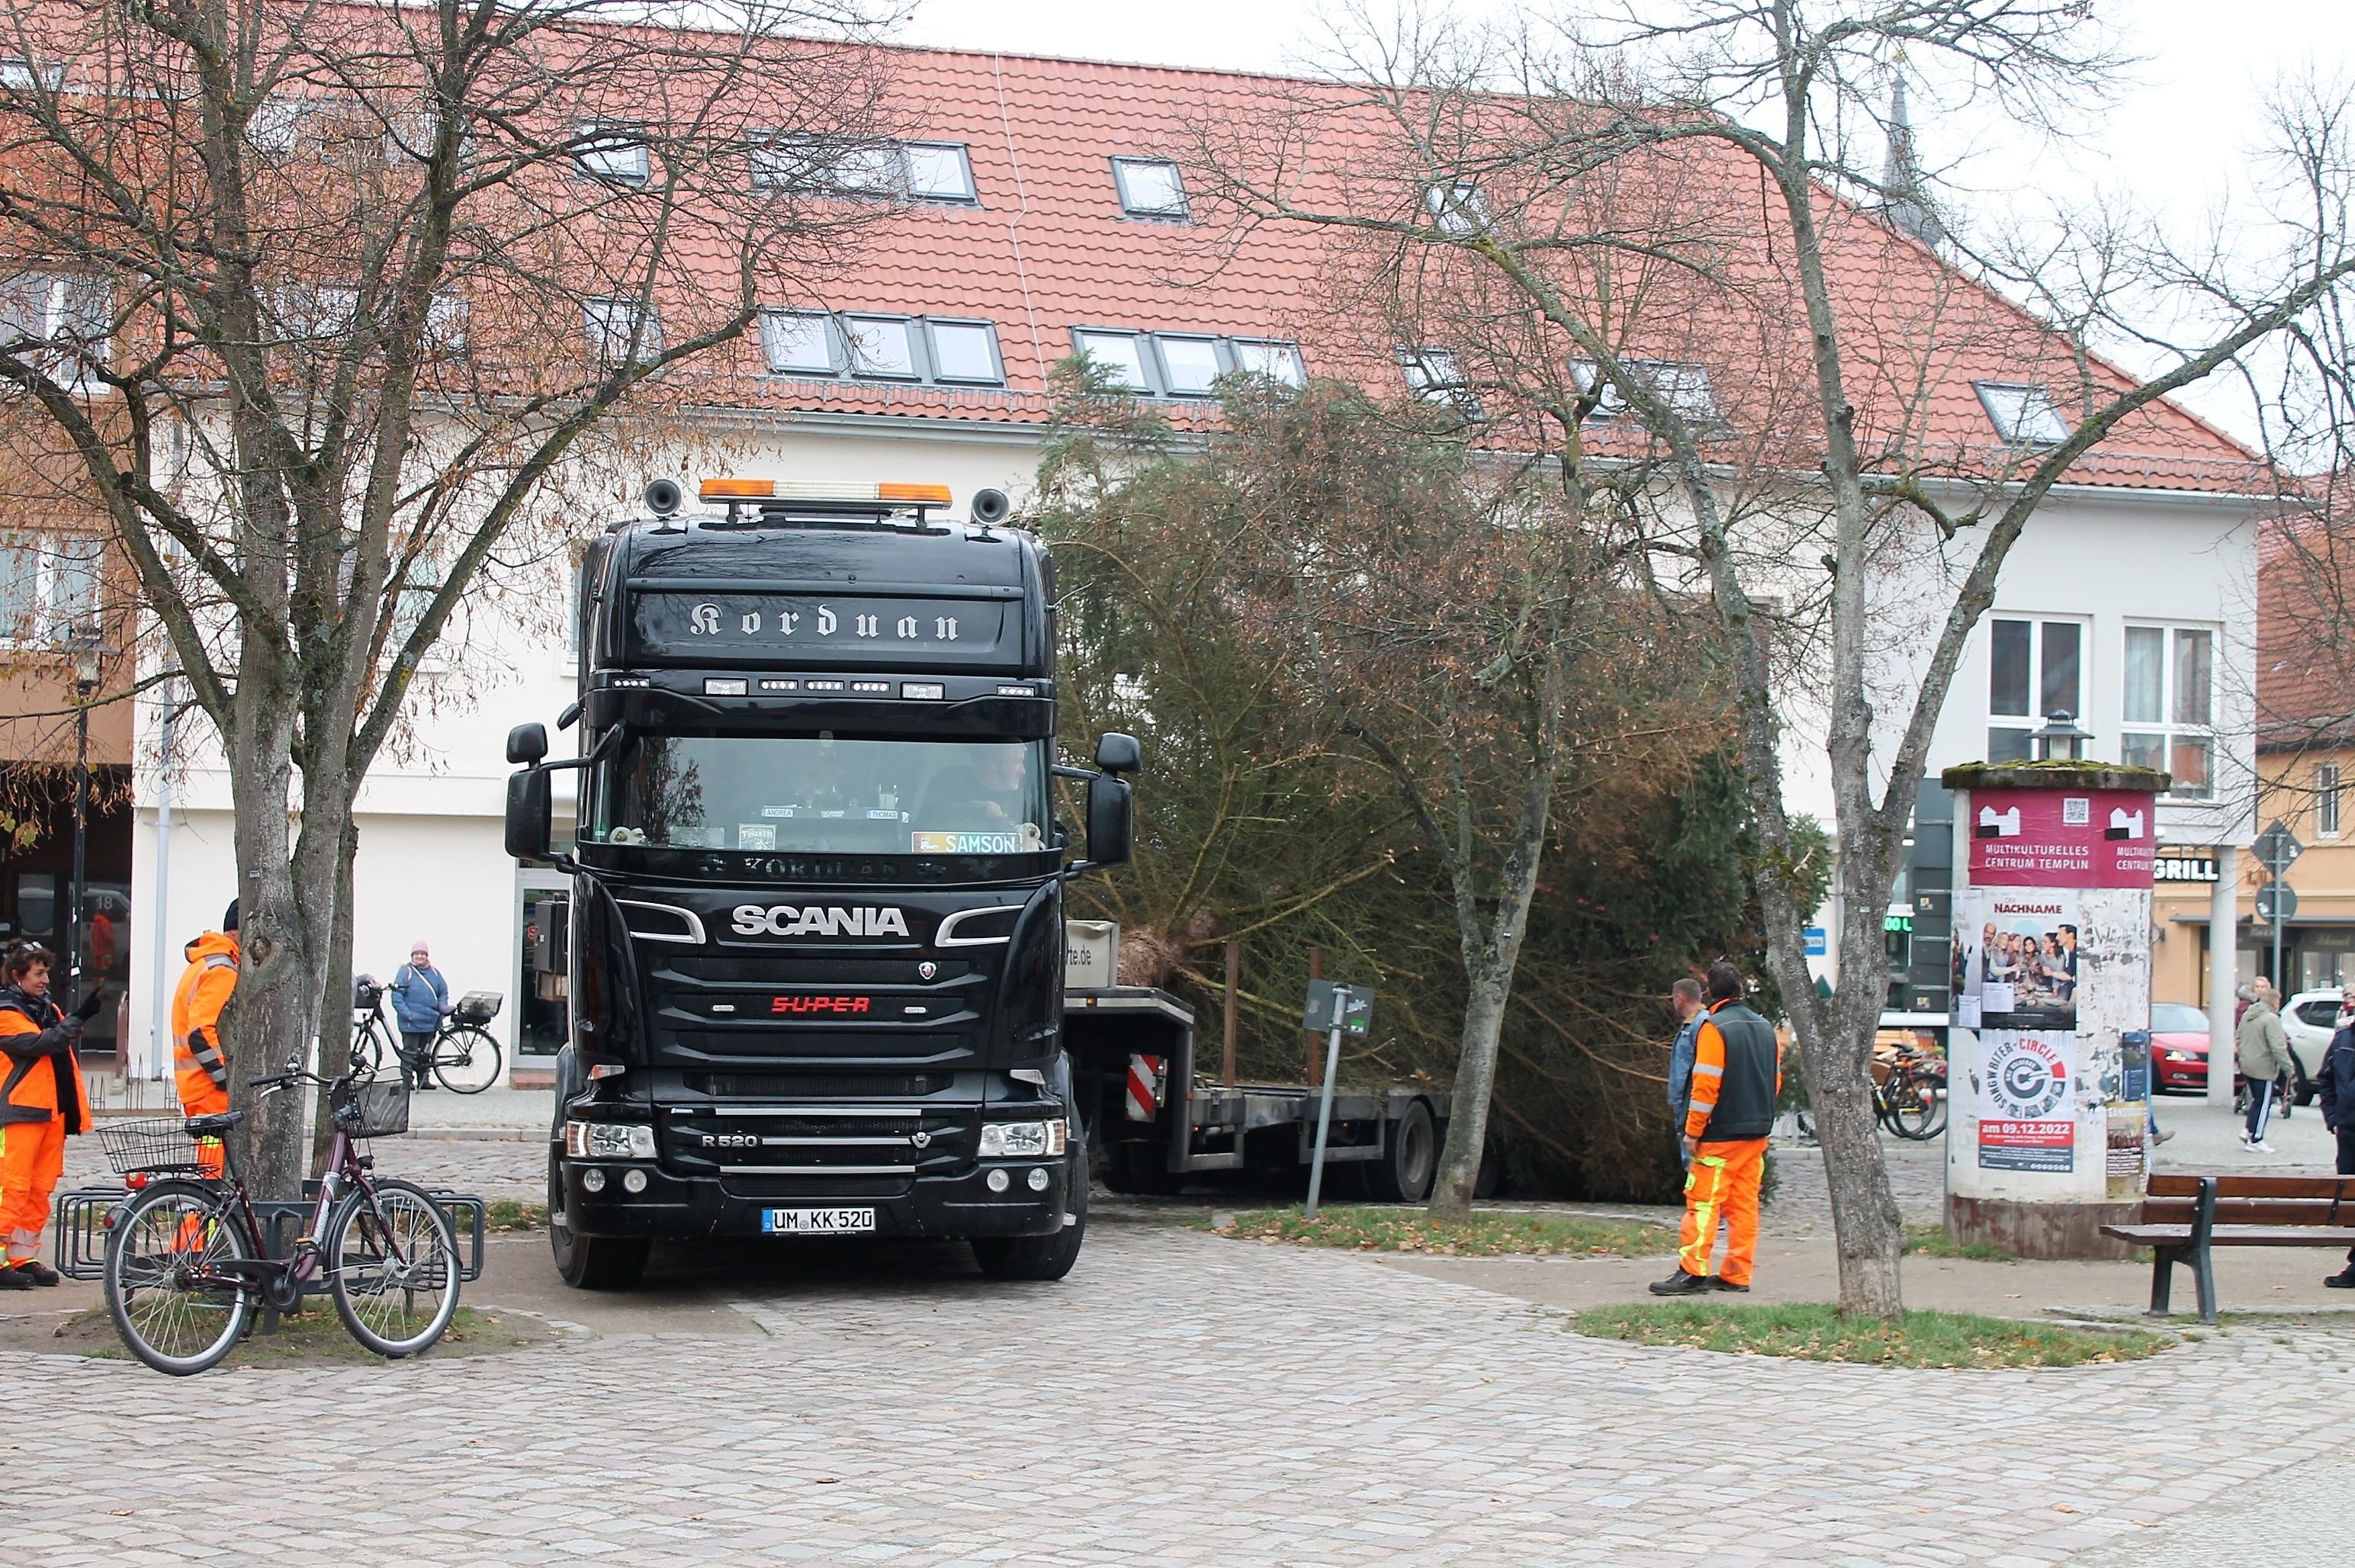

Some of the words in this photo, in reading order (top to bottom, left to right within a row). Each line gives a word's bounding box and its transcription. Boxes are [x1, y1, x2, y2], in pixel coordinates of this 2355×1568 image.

[690, 602, 959, 641] Korduan
[946, 835, 1016, 853] SAMSON
[1985, 844, 2089, 856] MULTIKULTURELLES
[1985, 858, 2035, 869] CENTRUM
[2039, 858, 2089, 869] TEMPLIN
[2153, 859, 2218, 880] GRILL
[96, 896, 113, 910] 18
[1994, 903, 2062, 914] NACHNAME
[731, 904, 910, 937] SCANIA
[771, 997, 870, 1013] SUPER
[2002, 1123, 2070, 1134] 09.12.2022
[774, 1212, 798, 1229] UM
[811, 1211, 834, 1229] KK
[838, 1211, 872, 1228] 520
